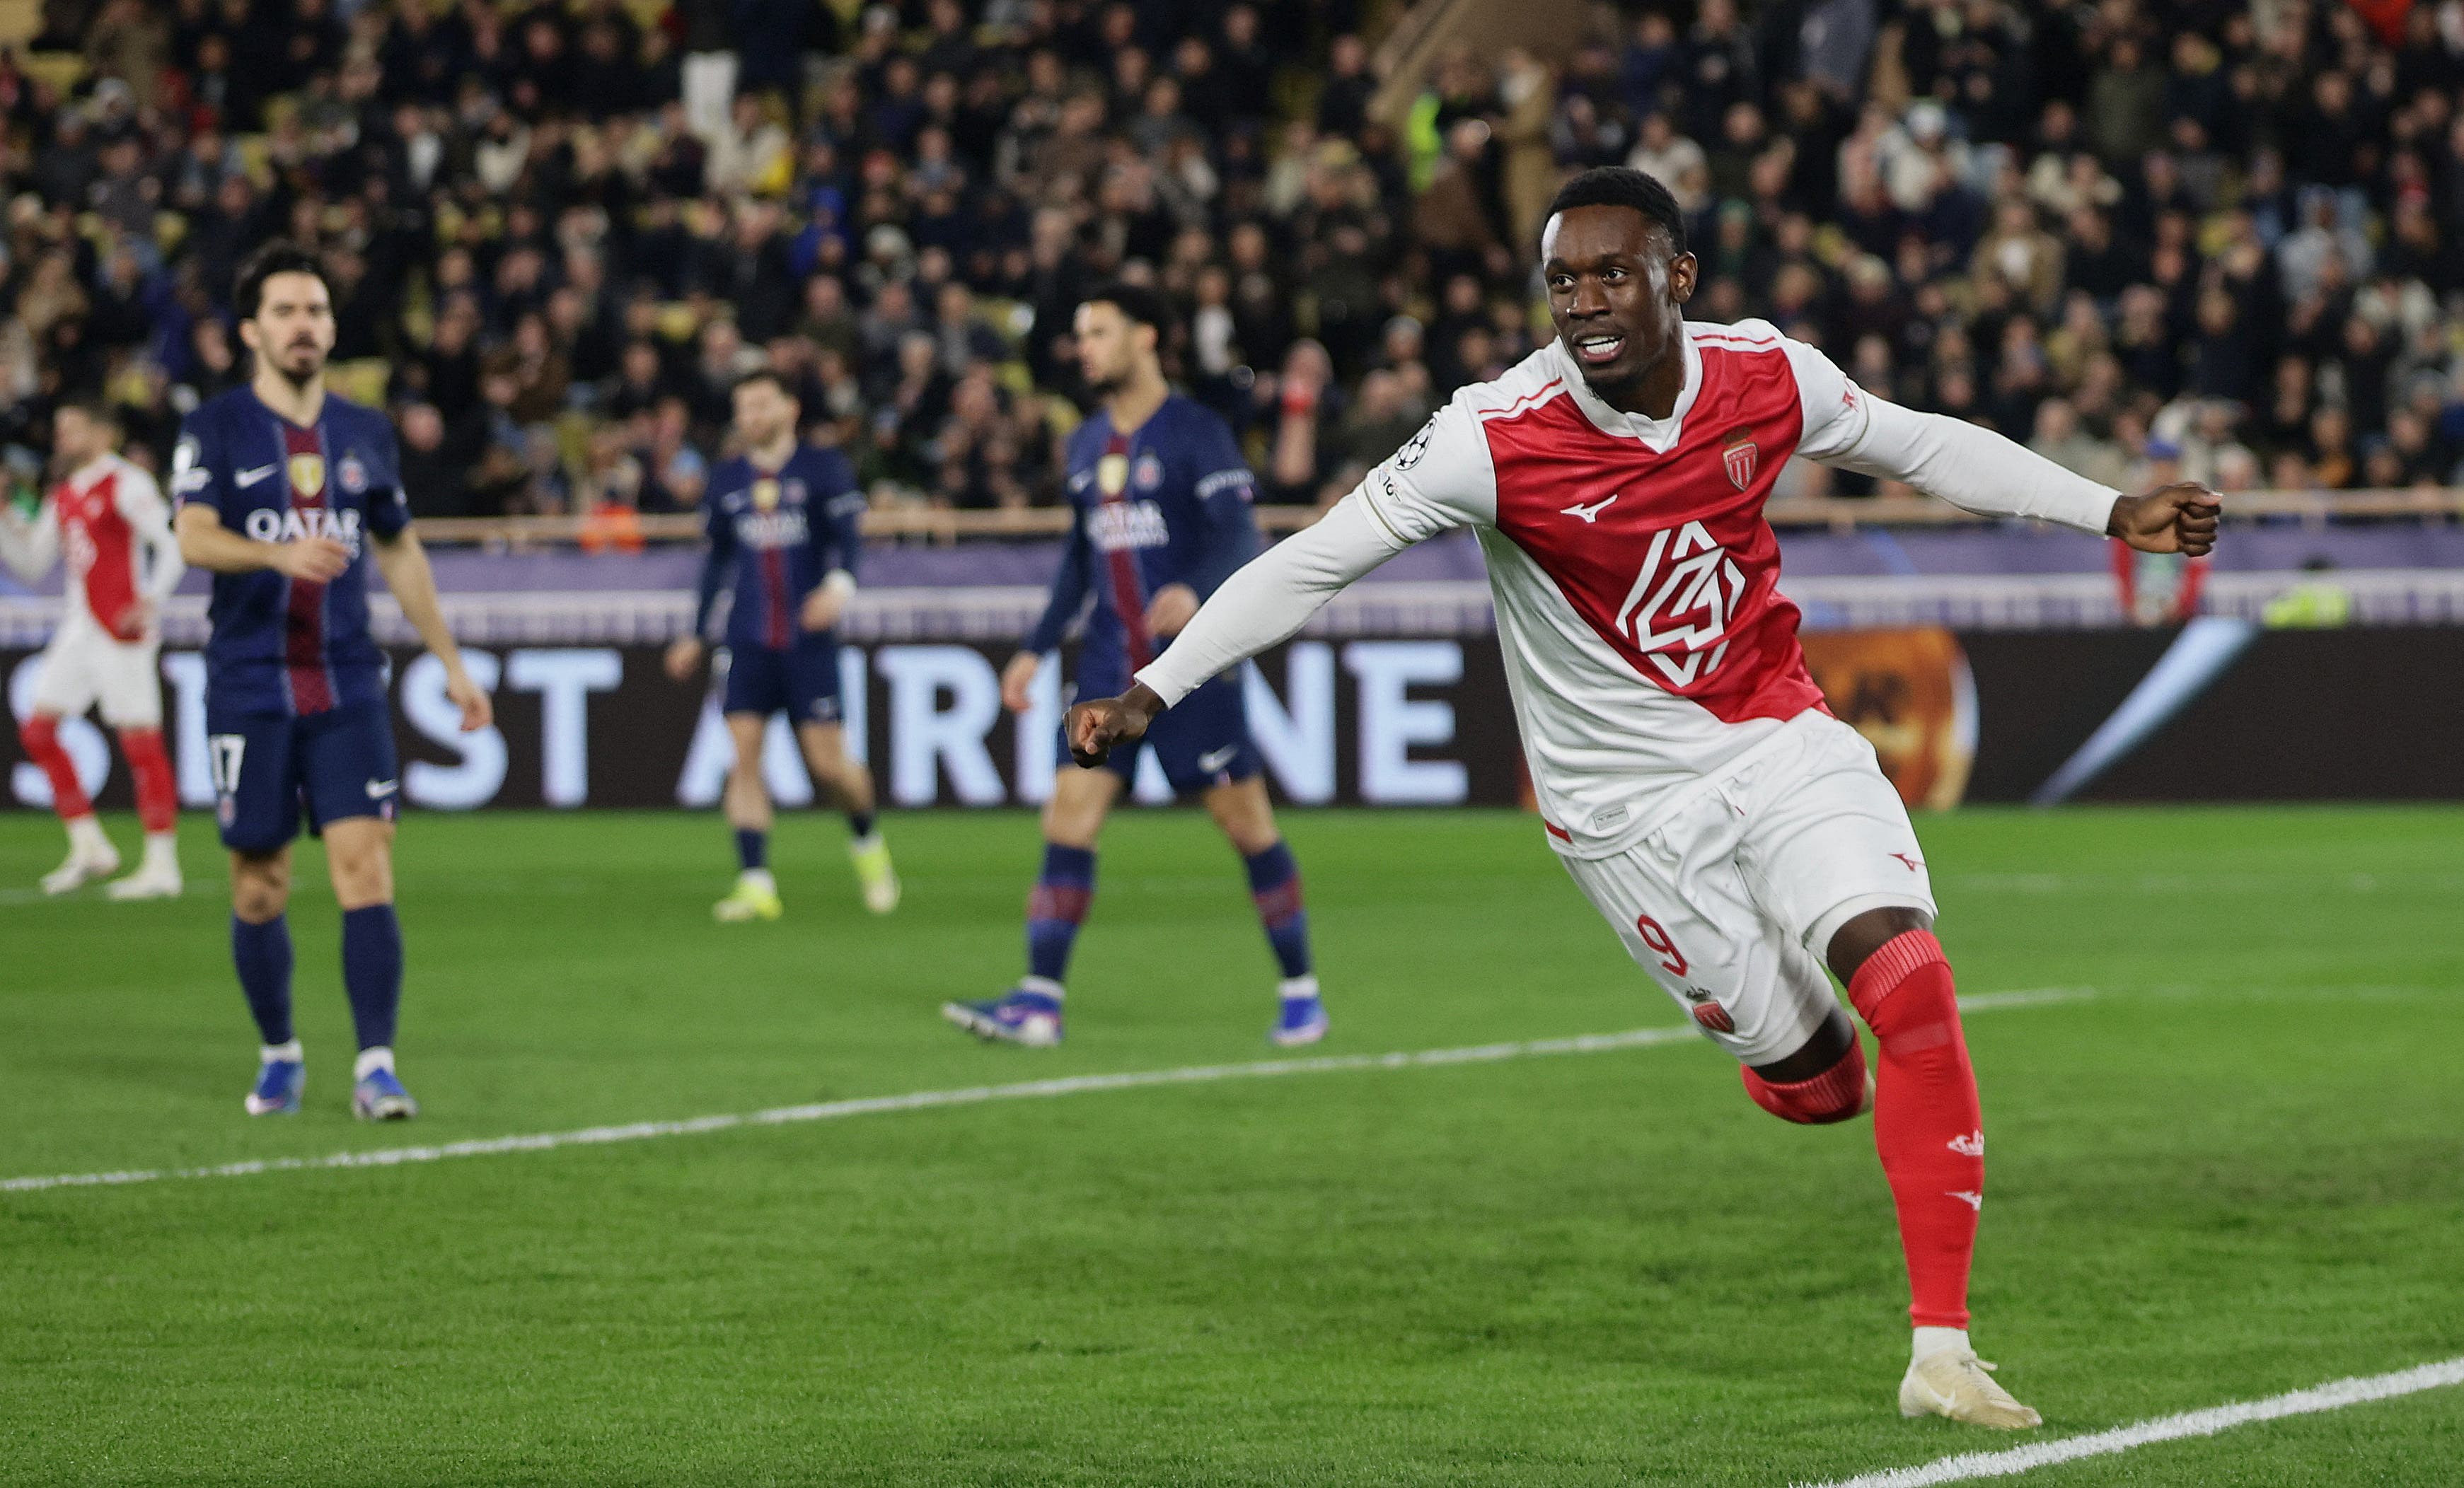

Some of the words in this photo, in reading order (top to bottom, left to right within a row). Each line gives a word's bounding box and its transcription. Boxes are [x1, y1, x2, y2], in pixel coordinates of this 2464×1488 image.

[245, 508, 361, 543] QATAR
[8, 646, 112, 808] S
[209, 734, 246, 792] 17
[1638, 914, 1689, 978] 9
